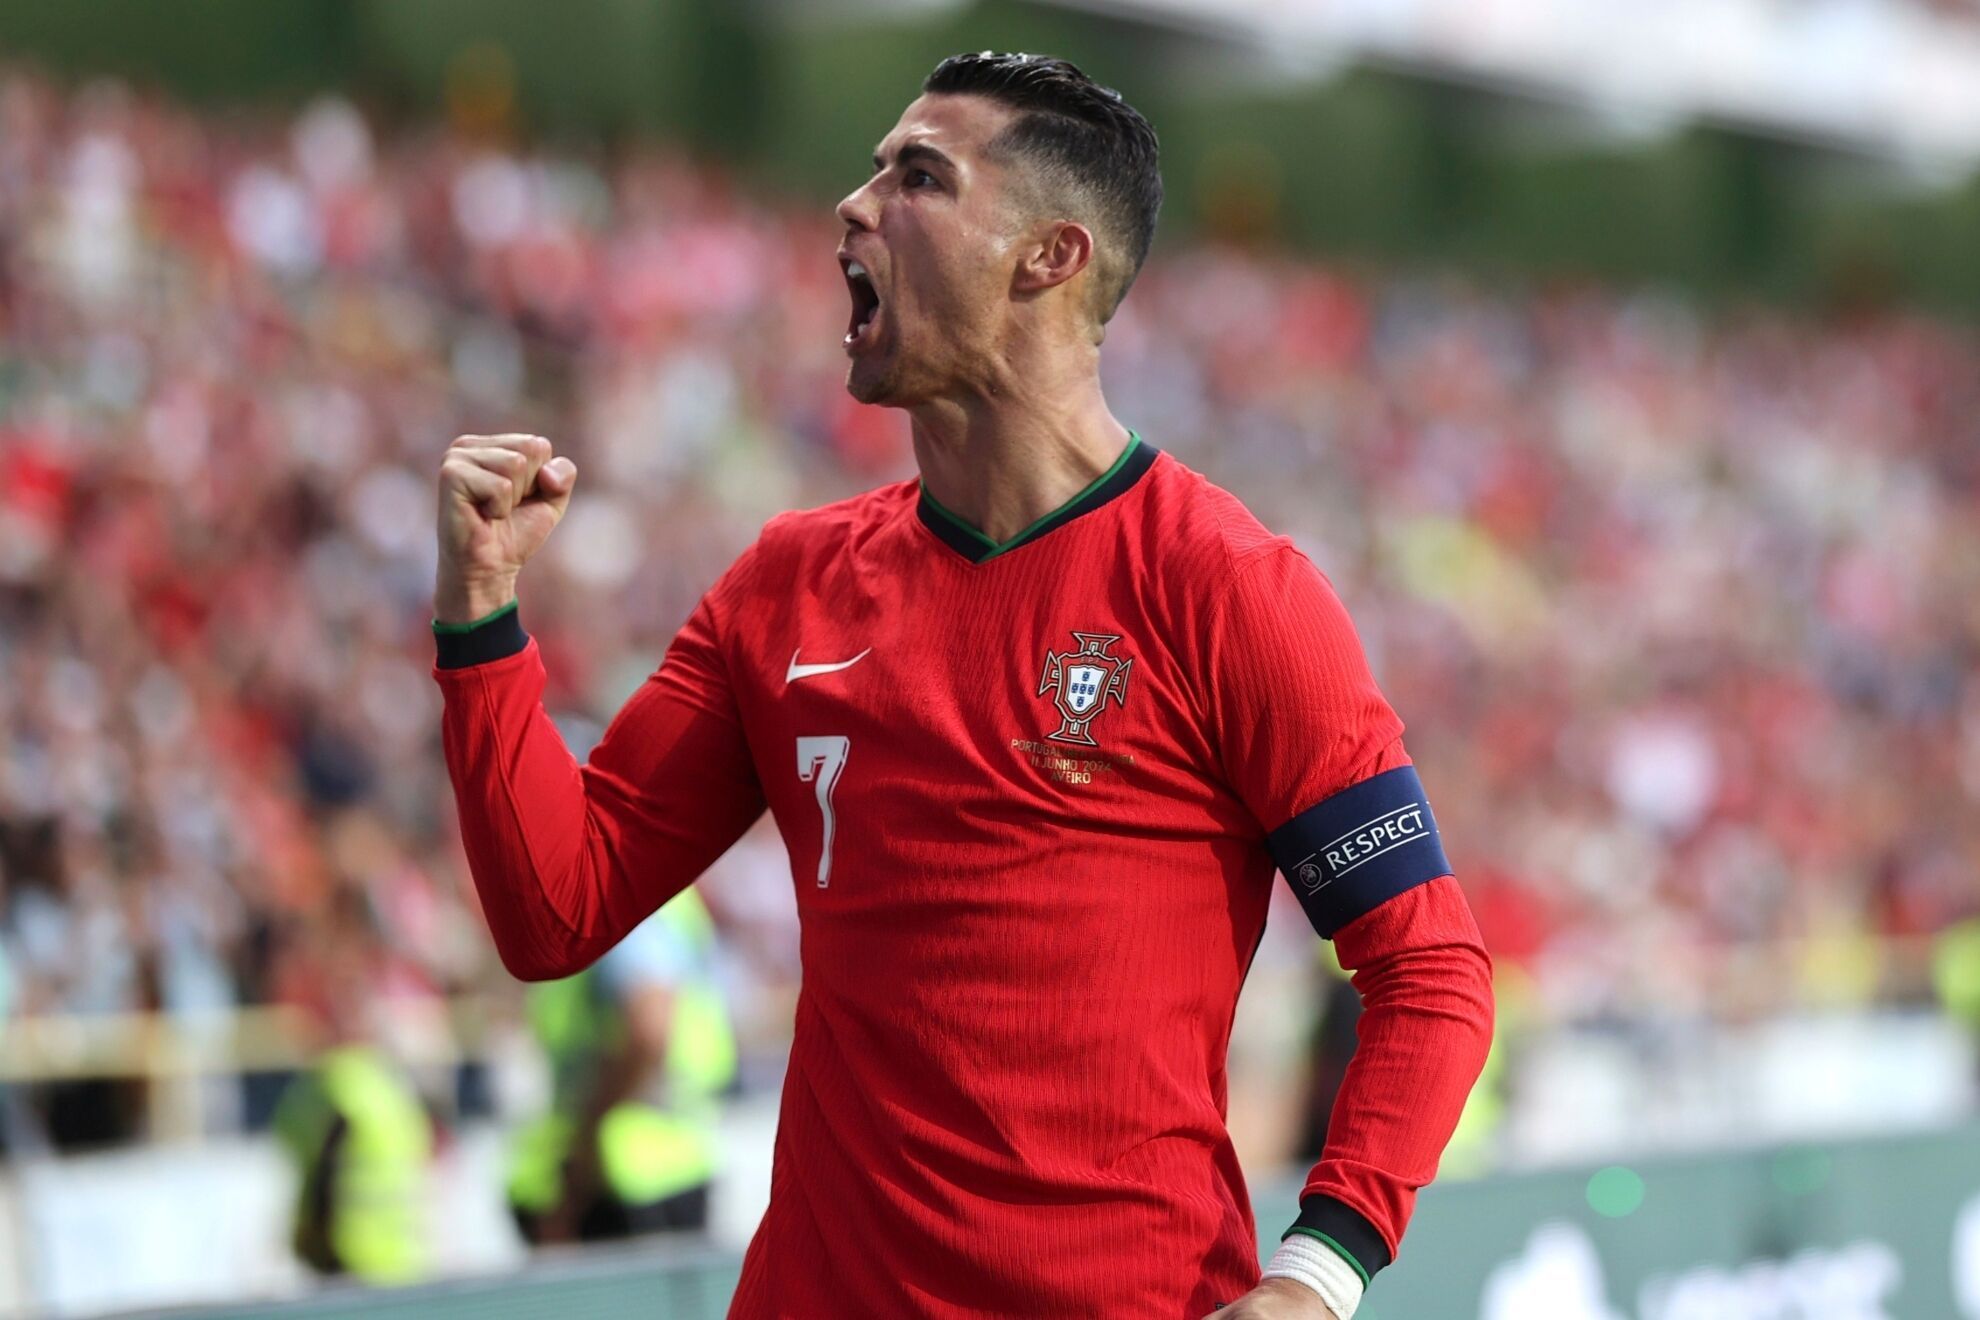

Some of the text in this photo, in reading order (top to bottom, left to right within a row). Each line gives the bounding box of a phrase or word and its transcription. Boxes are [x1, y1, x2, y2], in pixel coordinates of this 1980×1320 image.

[1011, 739, 1062, 757] PORTUGAL
[1042, 757, 1077, 771] JUNHO
[1051, 770, 1091, 784] AVEIRO
[796, 736, 850, 888] 7
[1325, 810, 1423, 871] RESPECT
